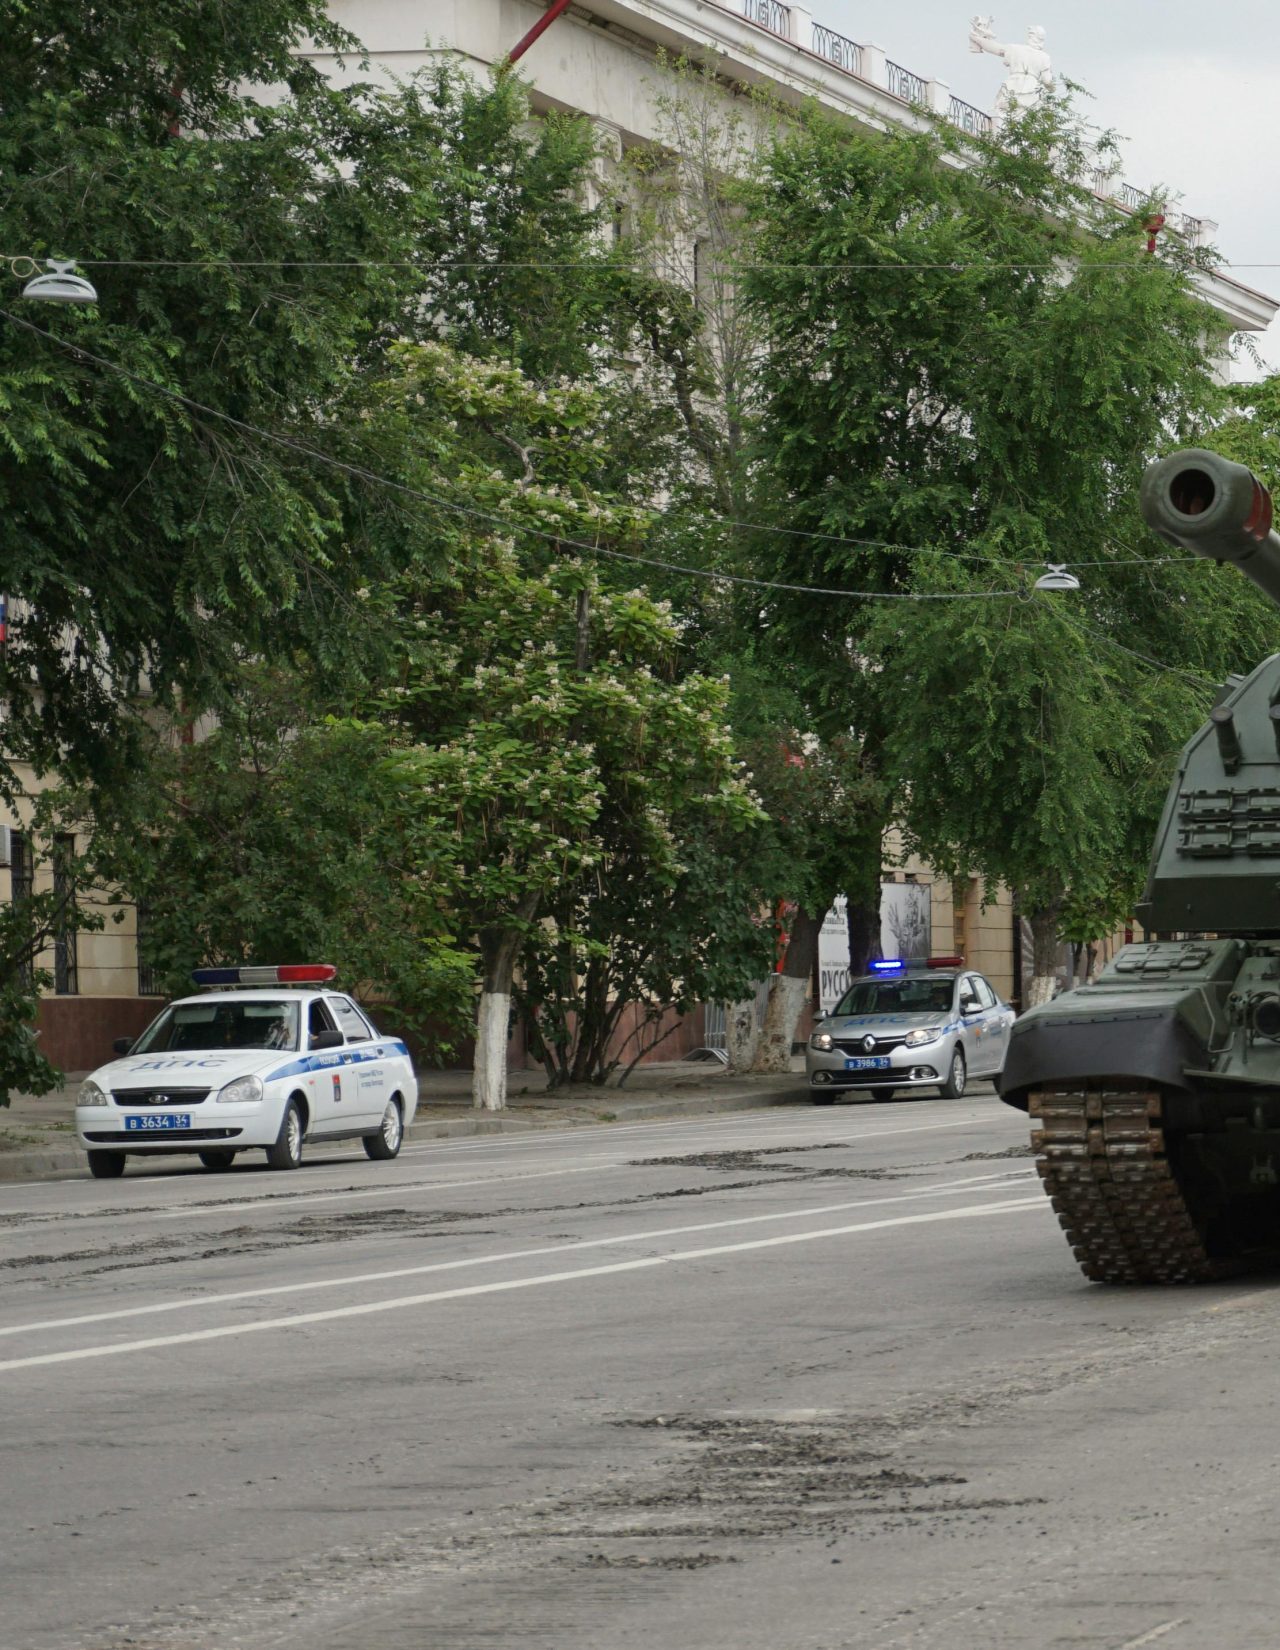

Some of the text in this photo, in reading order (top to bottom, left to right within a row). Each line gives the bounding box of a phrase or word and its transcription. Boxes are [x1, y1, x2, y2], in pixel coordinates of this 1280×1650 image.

[843, 1017, 906, 1027] ДПС
[129, 1060, 228, 1072] ДПС
[141, 1116, 169, 1128] 3634
